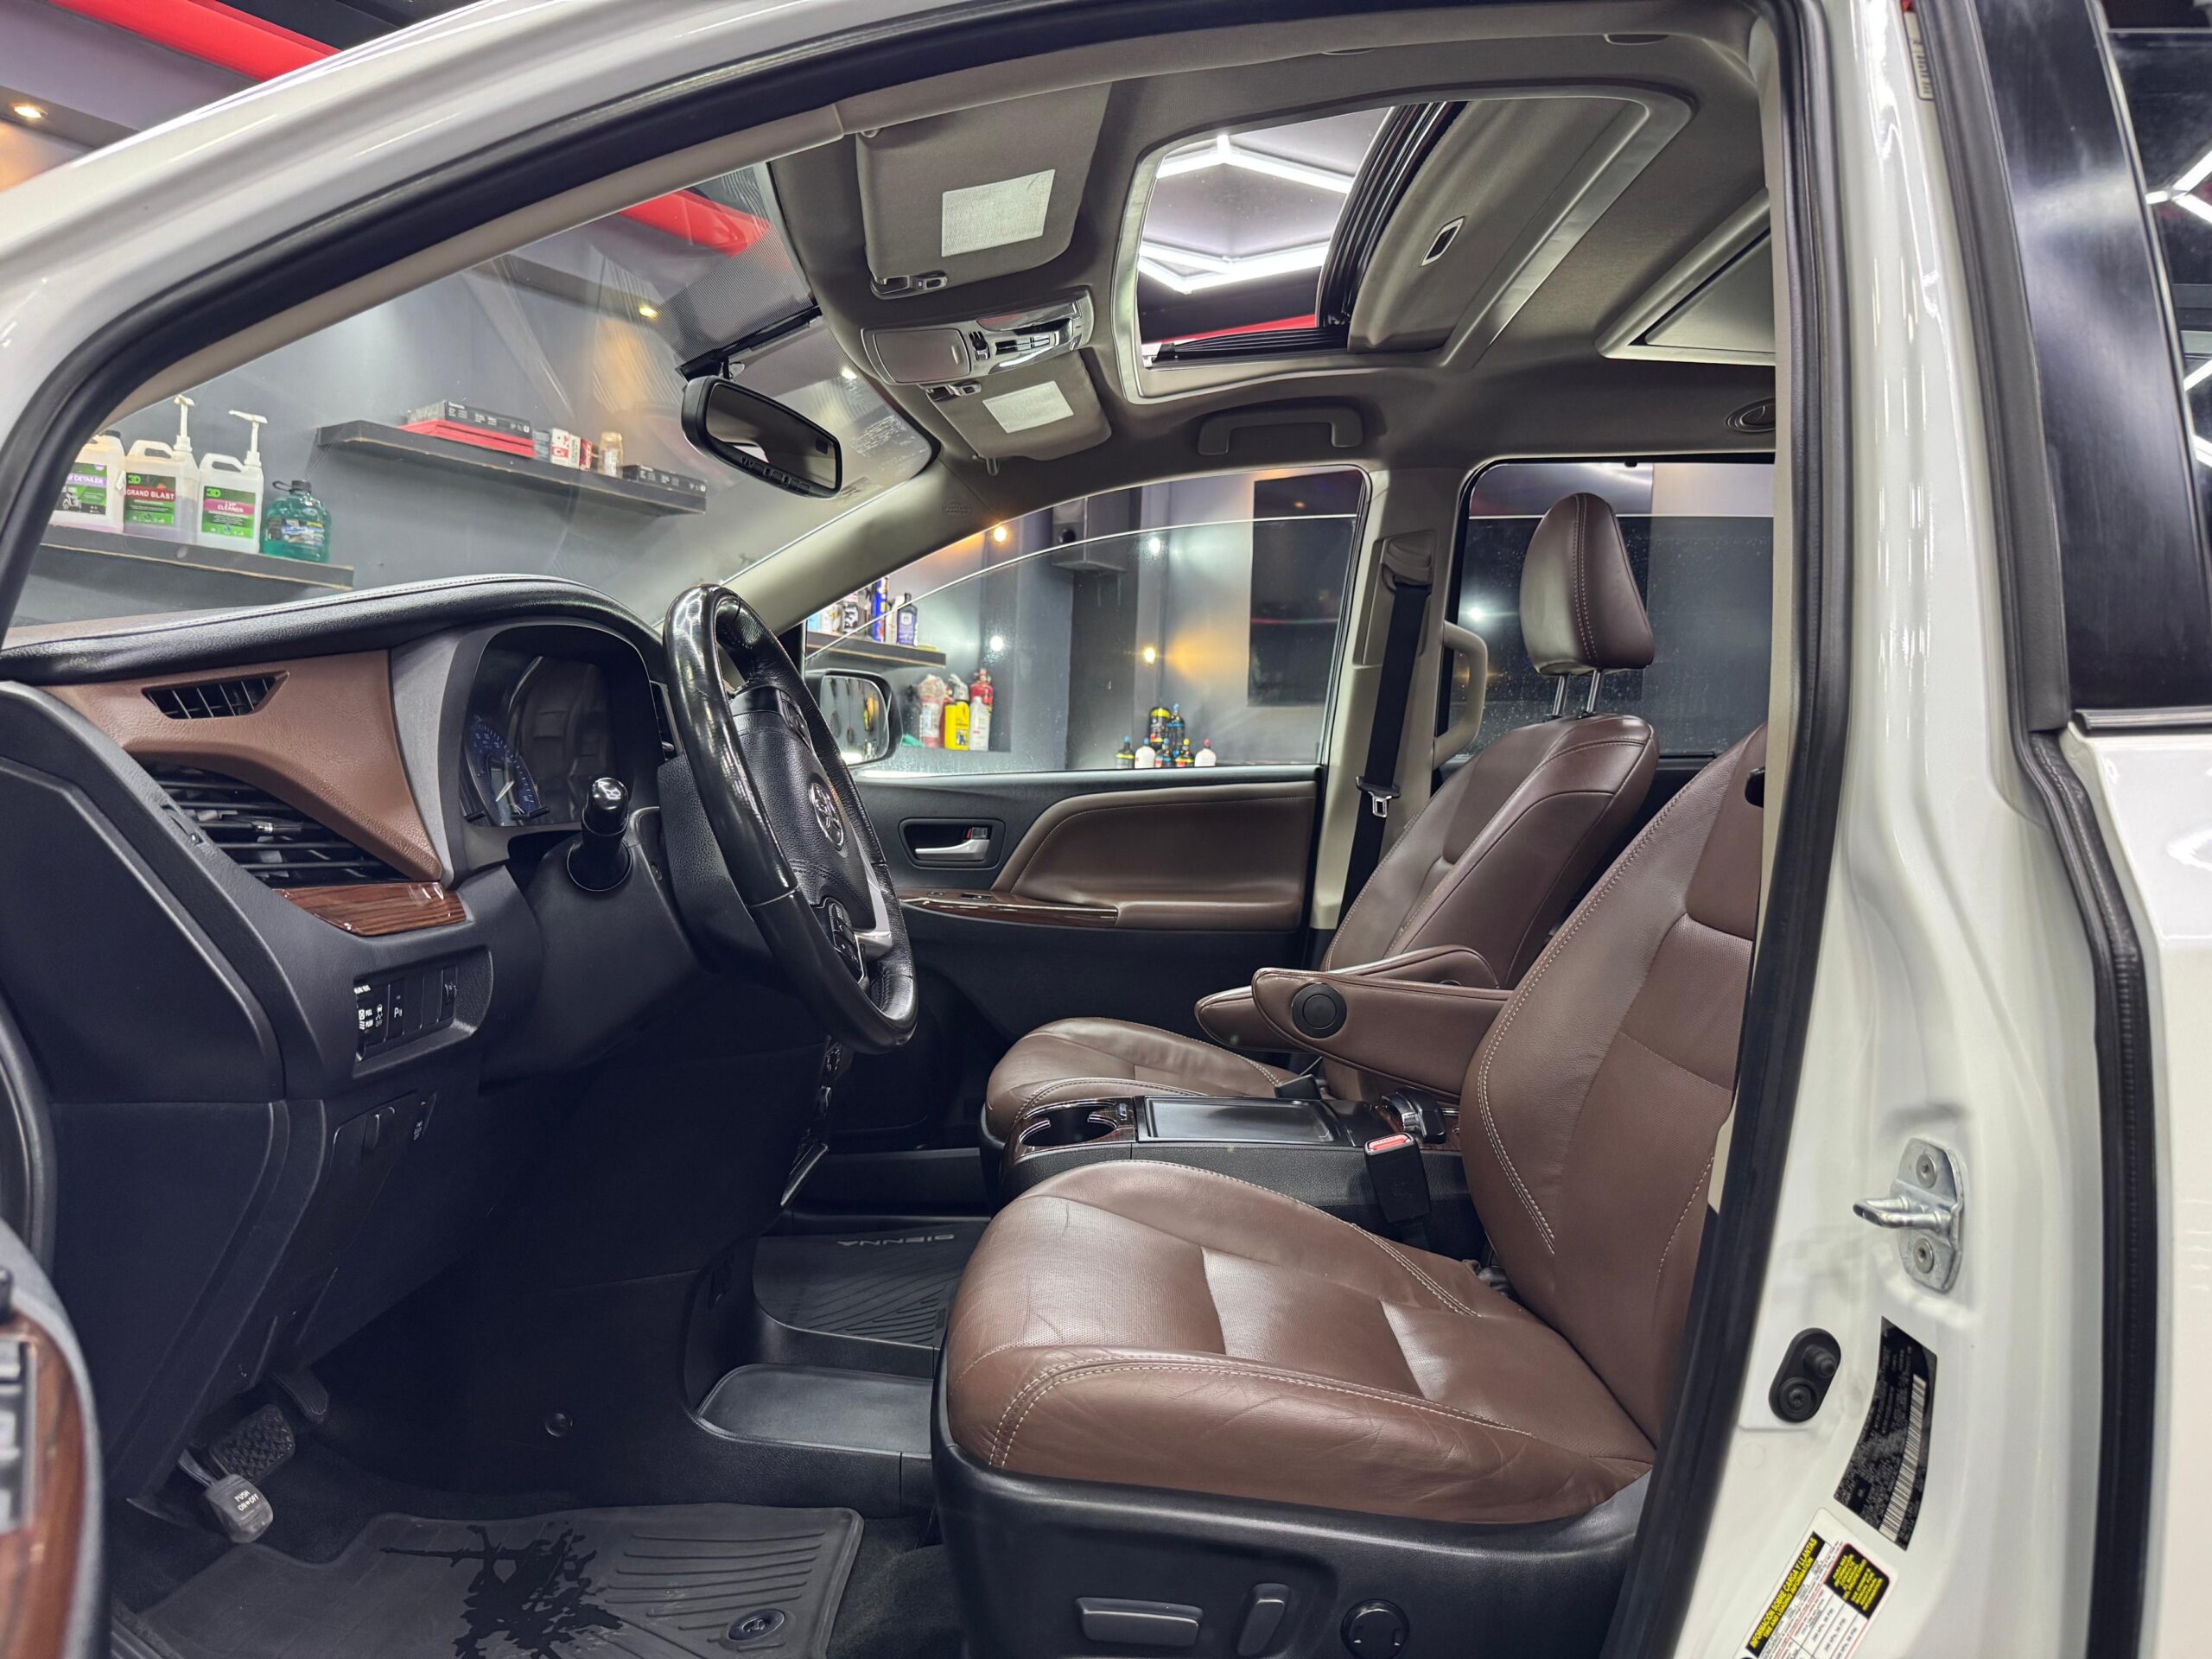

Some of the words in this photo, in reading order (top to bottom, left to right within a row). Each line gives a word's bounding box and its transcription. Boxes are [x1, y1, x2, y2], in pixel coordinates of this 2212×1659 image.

[74, 474, 104, 485] DETAILER
[127, 475, 141, 485] 3D
[126, 488, 149, 499] GRAND
[150, 490, 176, 500] BLAST
[206, 488, 221, 498] 3D
[217, 504, 245, 513] CLEANER
[234, 1489, 251, 1503] PUSH
